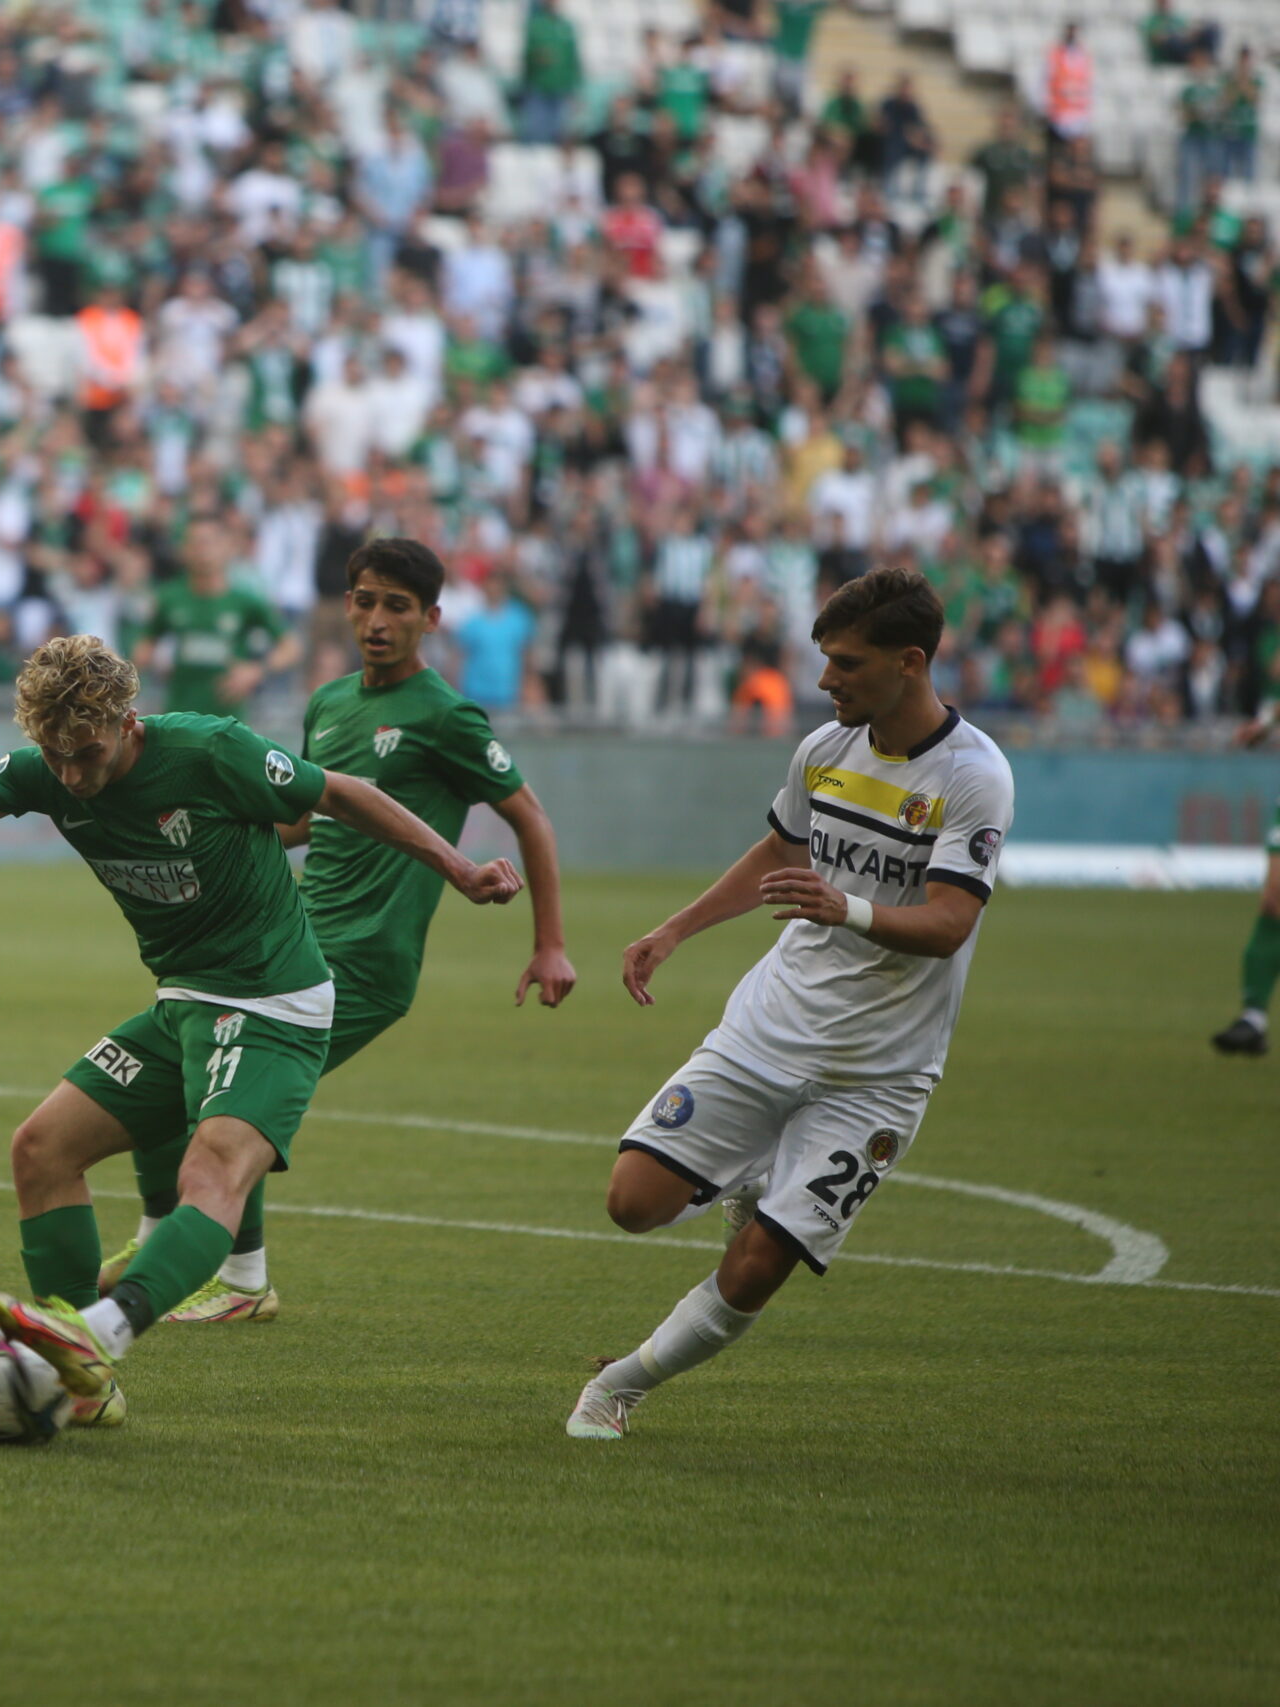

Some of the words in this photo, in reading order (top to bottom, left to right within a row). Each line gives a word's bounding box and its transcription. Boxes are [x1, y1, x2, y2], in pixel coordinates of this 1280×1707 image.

[810, 829, 929, 888] OLKART
[206, 1046, 244, 1096] 11
[806, 1149, 880, 1220] 28
